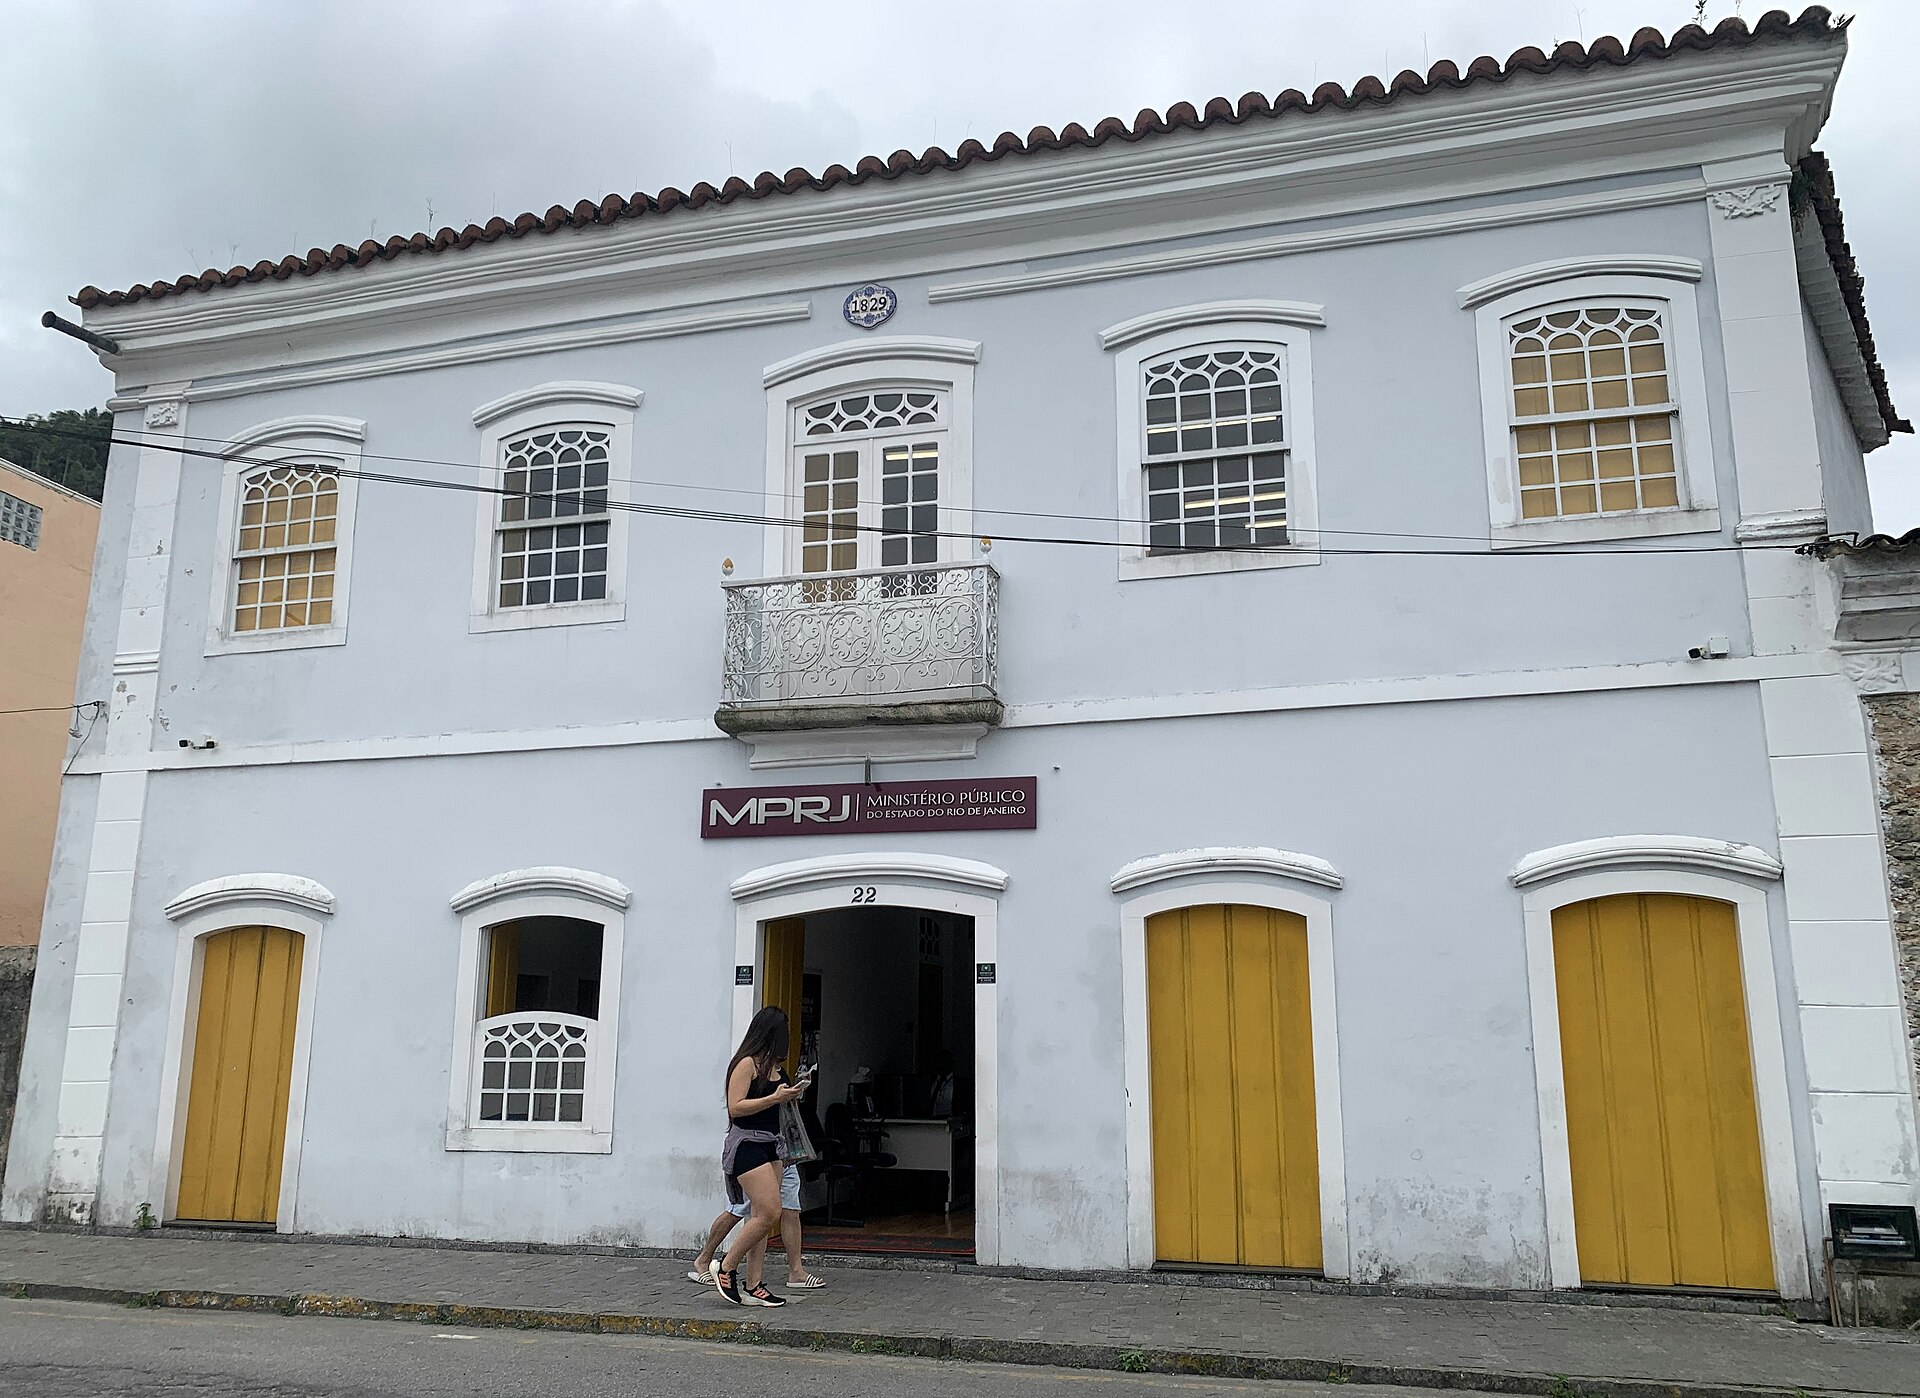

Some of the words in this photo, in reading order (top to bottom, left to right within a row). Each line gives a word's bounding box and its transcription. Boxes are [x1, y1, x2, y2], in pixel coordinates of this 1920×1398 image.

[851, 296, 887, 314] 1829
[866, 789, 955, 807] MINISTÉRIO
[960, 788, 1025, 804] PÚBLICO
[709, 794, 851, 826] MPRJ
[866, 810, 883, 819] DO
[885, 809, 925, 818] ESTADO
[927, 808, 944, 817] DO
[946, 807, 965, 816] RIO
[967, 806, 981, 815] DE
[983, 805, 1026, 816] JANEIRO
[851, 886, 876, 904] 22
